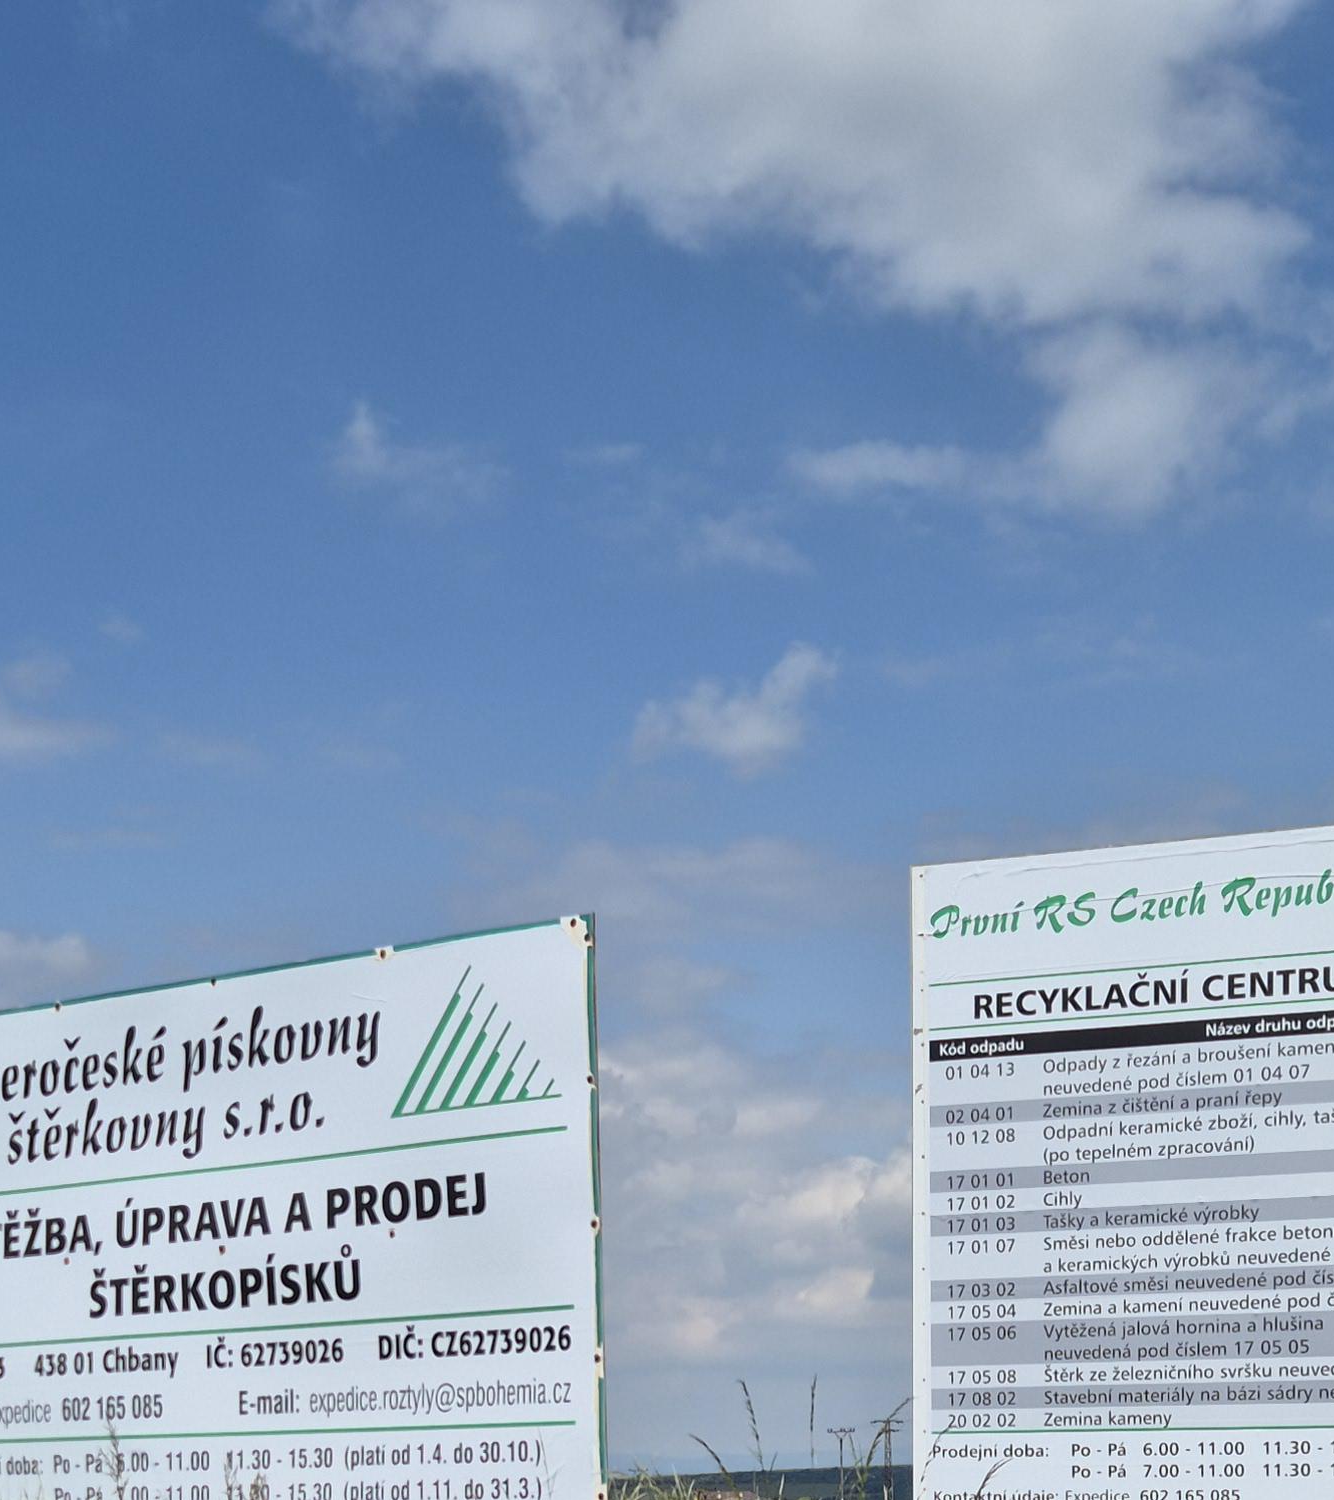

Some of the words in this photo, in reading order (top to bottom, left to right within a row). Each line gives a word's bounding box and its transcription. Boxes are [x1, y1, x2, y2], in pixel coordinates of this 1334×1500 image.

[930, 905, 1023, 938] První
[1033, 894, 1096, 934] RS
[1110, 881, 1206, 923] Czech
[974, 968, 1188, 1019] RECYKLAČNÍ
[182, 1005, 380, 1092] pískovny
[939, 1041, 965, 1056] Kód
[970, 1037, 1024, 1056] odpadu
[1206, 1021, 1250, 1036] Název
[1255, 1017, 1301, 1033] druhu
[945, 1065, 961, 1080] 01
[970, 1063, 989, 1078] 04
[997, 1062, 1014, 1076] 13
[1043, 1055, 1107, 1075] Odpady
[1112, 1058, 1120, 1068] z
[1127, 1050, 1175, 1067] řezání
[1182, 1052, 1190, 1063] a
[1197, 1043, 1270, 1062] broušení
[1043, 1076, 1132, 1095] neuvedené
[1138, 1072, 1169, 1093] pod
[1175, 1070, 1227, 1087] číslem
[1233, 1067, 1251, 1083] 01
[1261, 1065, 1282, 1081] 04
[1288, 1063, 1309, 1079] 07
[945, 1109, 964, 1124] 02
[970, 1107, 989, 1122] 04
[995, 1106, 1012, 1121] 01
[1042, 1100, 1101, 1118] Zemina
[1108, 1103, 1116, 1114] z
[1122, 1095, 1174, 1113] čištění
[1180, 1098, 1189, 1109] a
[1196, 1090, 1238, 1111] praní
[1245, 1090, 1281, 1107] řepy
[7, 1097, 205, 1165] štěrkovny
[223, 1091, 324, 1139] s.r.o.
[947, 1131, 964, 1145] 10
[972, 1129, 989, 1144] 12
[995, 1128, 1015, 1143] 08
[1043, 1121, 1112, 1142] Odpadní
[1119, 1116, 1202, 1135] keramické
[1208, 1112, 1257, 1130] zboží,
[1264, 1110, 1306, 1129] cihly,
[1043, 1147, 1069, 1165] (po
[1075, 1142, 1151, 1163] tepelném
[1158, 1135, 1254, 1159] zpracování)
[947, 1175, 964, 1189] 17
[970, 1174, 987, 1188] 01
[996, 1172, 1012, 1187] 01
[1043, 1170, 1089, 1184] Beton
[116, 1196, 270, 1248] ÚPRAVA
[284, 1192, 311, 1233] A
[326, 1172, 486, 1229] PRODEJ
[947, 1197, 964, 1211] 17
[971, 1195, 987, 1210] 01
[996, 1194, 1014, 1209] 02
[1043, 1191, 1081, 1208] Cihly
[948, 1219, 965, 1232] 17
[971, 1217, 987, 1232] 01
[996, 1216, 1015, 1231] 03
[1043, 1213, 1084, 1230] Tašky
[1090, 1215, 1098, 1226] a
[1105, 1207, 1188, 1225] keramické
[1193, 1204, 1259, 1224] výrobky
[948, 1240, 964, 1254] 17
[971, 1240, 987, 1254] 01
[996, 1238, 1015, 1253] 07
[1043, 1234, 1088, 1250] Směsi
[1095, 1233, 1136, 1248] nebo
[1142, 1228, 1219, 1246] oddělené
[1225, 1226, 1276, 1242] frakce
[1043, 1262, 1051, 1273] a
[1058, 1253, 1157, 1272] keramických
[1163, 1250, 1229, 1271] výrobků
[1237, 1246, 1330, 1265] neuvedené
[89, 1244, 360, 1318] ŠTĚRKOPÍSKŮ
[948, 1284, 965, 1298] 17
[971, 1283, 990, 1297] 03
[996, 1282, 1015, 1296] 02
[1043, 1277, 1118, 1295] Asfaltové
[1124, 1275, 1168, 1292] směsi
[1175, 1272, 1266, 1290] neuvedené
[1273, 1270, 1305, 1289] pod
[34, 1353, 67, 1376] 438
[74, 1351, 93, 1375] 01
[102, 1346, 178, 1378] Chbany
[206, 1336, 232, 1368] IČ:
[240, 1338, 343, 1367] 62739026
[378, 1325, 423, 1360] DIČ:
[431, 1325, 571, 1357] CZ62739026
[62, 1396, 90, 1421] 602
[96, 1395, 125, 1421] 165
[131, 1393, 162, 1419] 085
[238, 1388, 299, 1415] E-mail:
[309, 1378, 571, 1417] expedice.roztyly@spbohemia.cz
[946, 1414, 966, 1429] 20
[972, 1413, 990, 1427] 02
[997, 1413, 1016, 1427] 02
[1044, 1411, 1101, 1426] Zemina
[1108, 1410, 1171, 1427] kameny
[6, 1455, 42, 1476] doba:
[53, 1454, 70, 1474] Po
[166, 1450, 209, 1471] 11.00
[289, 1447, 333, 1468] 15.30
[344, 1445, 385, 1470] (platí
[391, 1444, 410, 1465] od
[417, 1443, 446, 1464] 1.4.
[453, 1442, 473, 1464] do
[479, 1439, 543, 1466] 30.10.)
